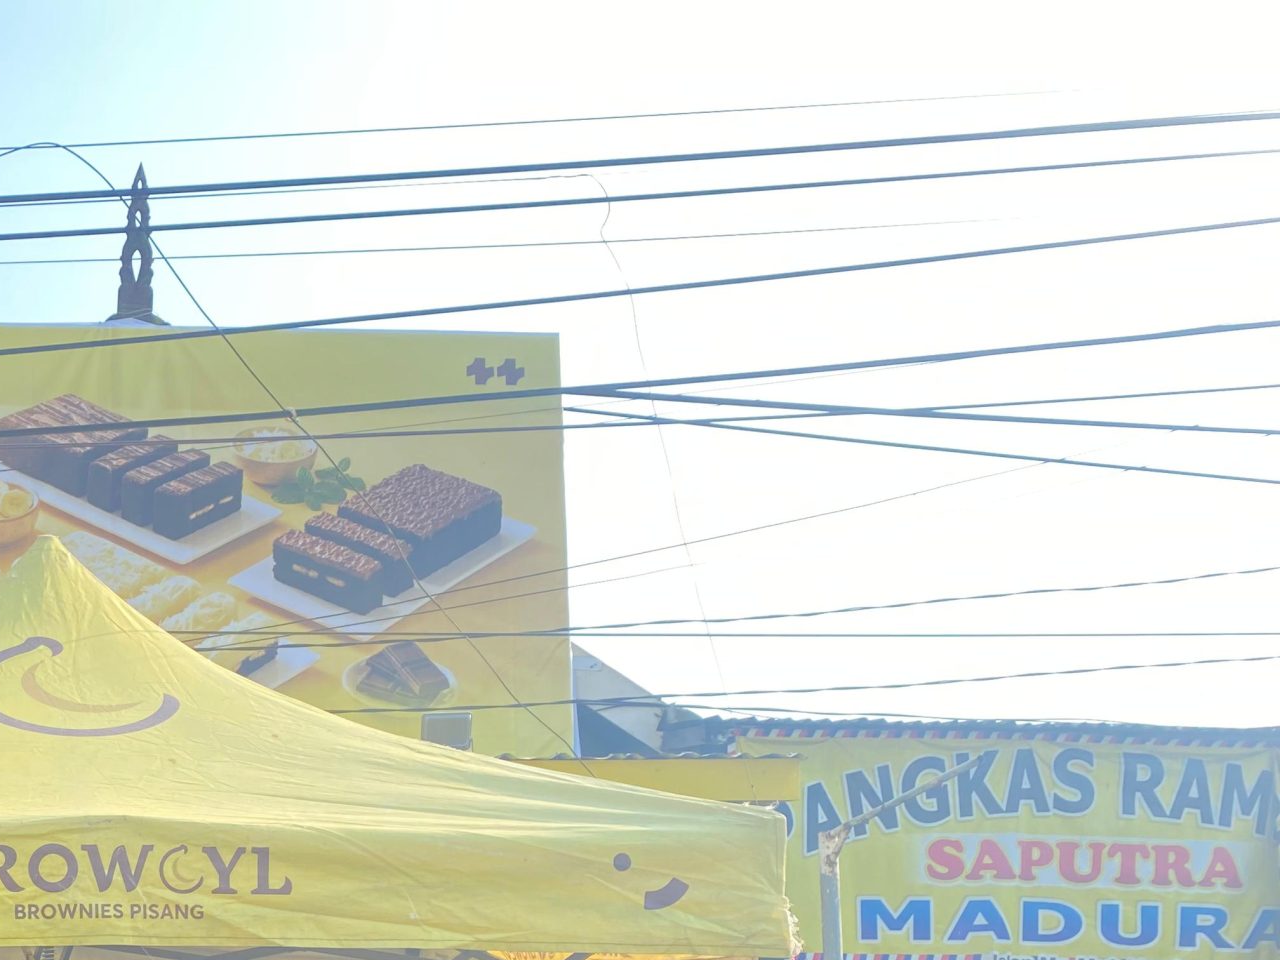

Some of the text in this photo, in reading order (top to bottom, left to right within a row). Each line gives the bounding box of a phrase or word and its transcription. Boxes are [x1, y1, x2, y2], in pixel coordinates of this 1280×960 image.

[1122, 752, 1280, 838] RAM
[926, 838, 1244, 889] SAPUTRA
[14, 903, 205, 920] BROWNIES PISANG
[859, 897, 1280, 950] MADURA
